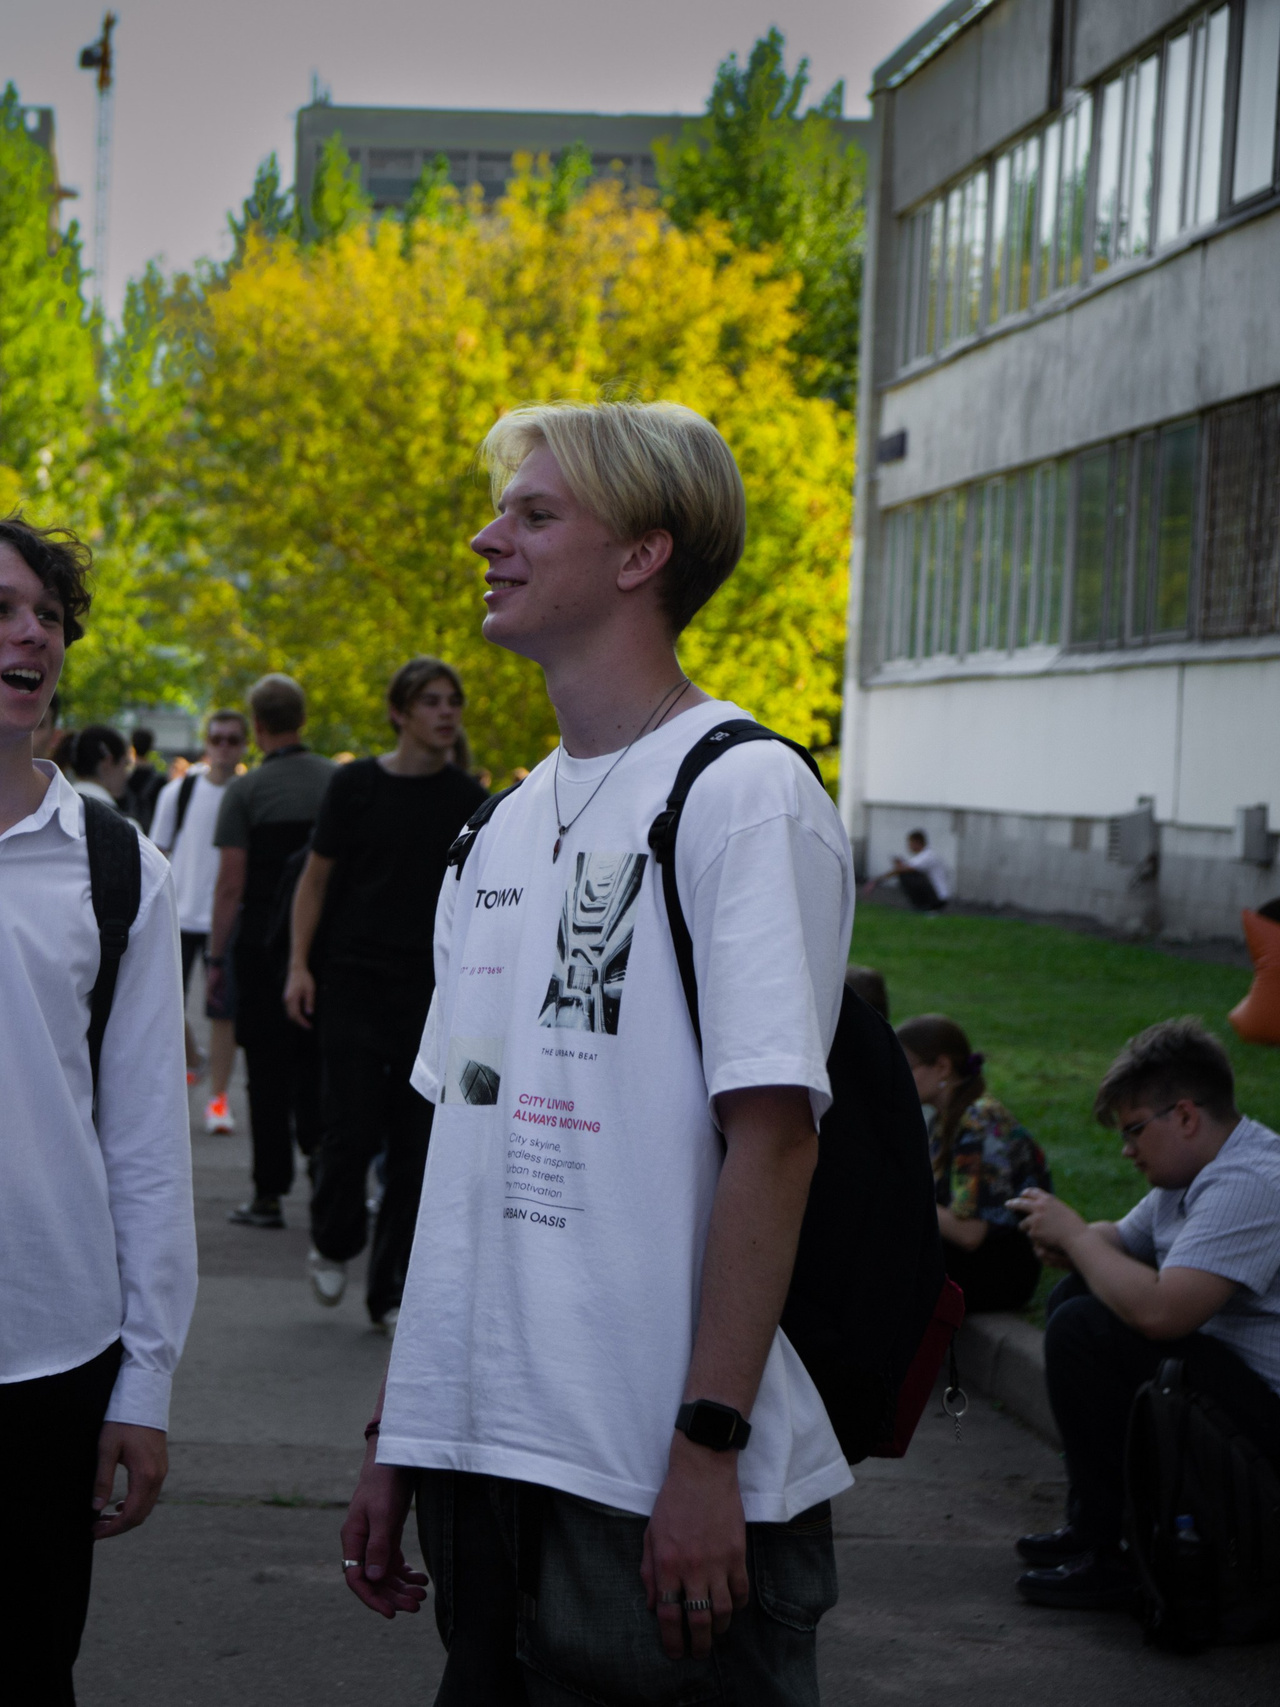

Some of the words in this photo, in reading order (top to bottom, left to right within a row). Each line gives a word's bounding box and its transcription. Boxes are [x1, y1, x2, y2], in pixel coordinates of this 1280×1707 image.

[475, 887, 524, 909] TOWN
[541, 1047, 554, 1056] THE
[554, 1049, 575, 1058] URBAN
[578, 1051, 598, 1061] BEAT
[518, 1093, 546, 1108] CITY
[546, 1098, 575, 1112] LIVING
[512, 1109, 557, 1127] ALWAYS
[559, 1117, 601, 1133] MOVING
[509, 1132, 528, 1146] City
[507, 1149, 542, 1164] endless
[512, 1181, 563, 1198] motivation
[529, 1211, 567, 1229] OASIS
